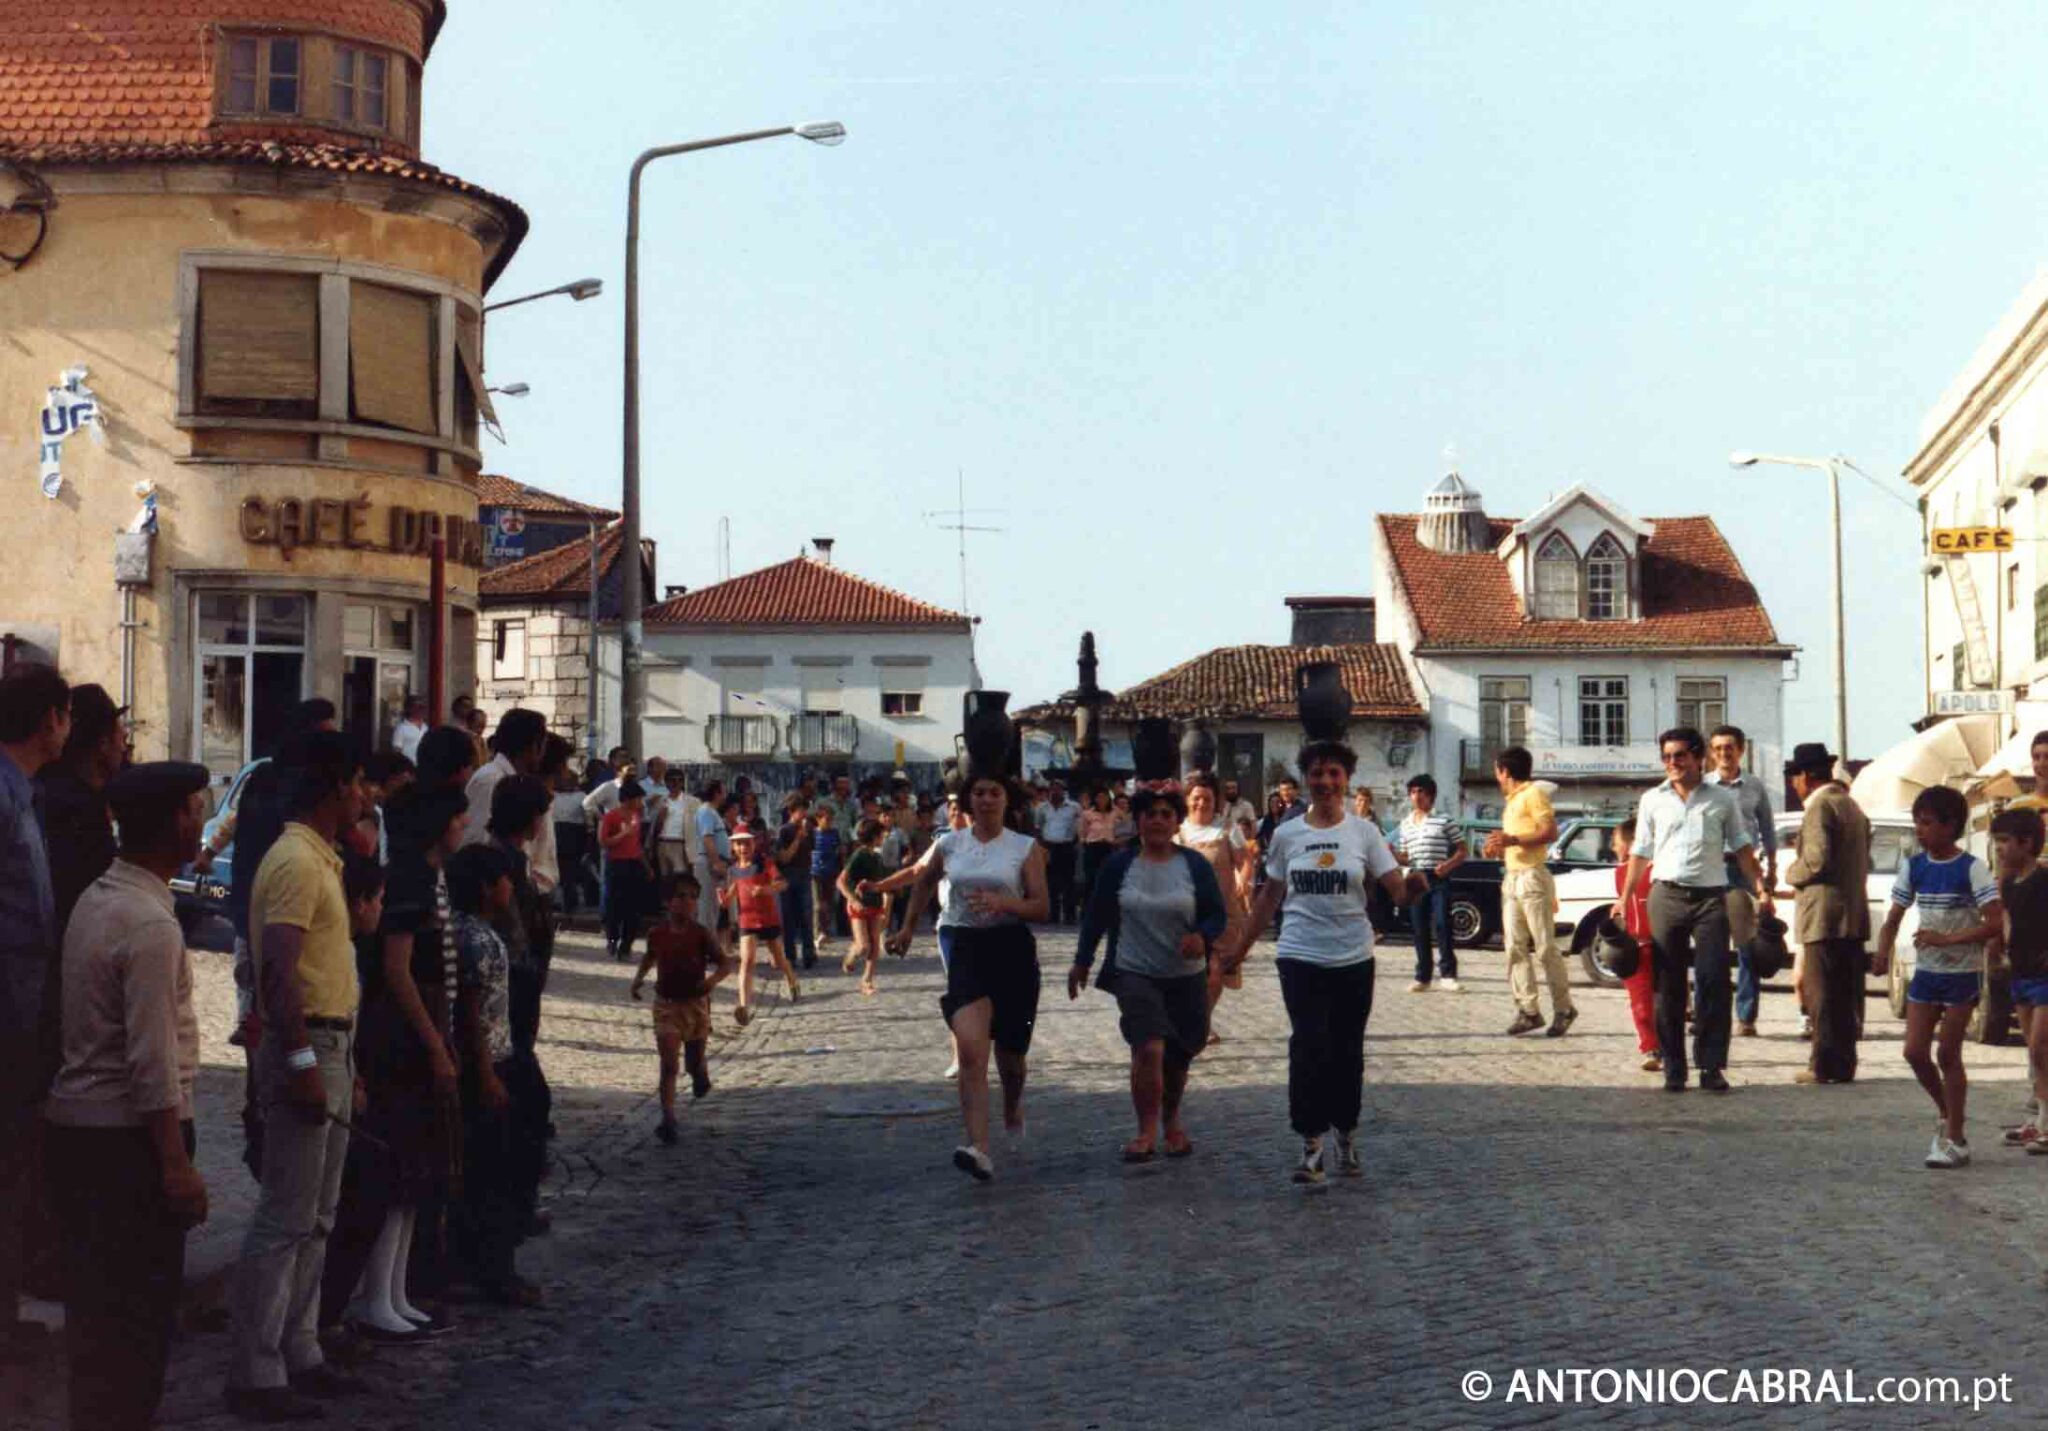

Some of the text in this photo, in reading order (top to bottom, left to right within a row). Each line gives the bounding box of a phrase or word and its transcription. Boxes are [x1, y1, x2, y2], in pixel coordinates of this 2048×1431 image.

[1935, 526, 2012, 550] CAFÉ
[1940, 693, 1999, 711] APOLO
[1290, 868, 1348, 895] EUROPA
